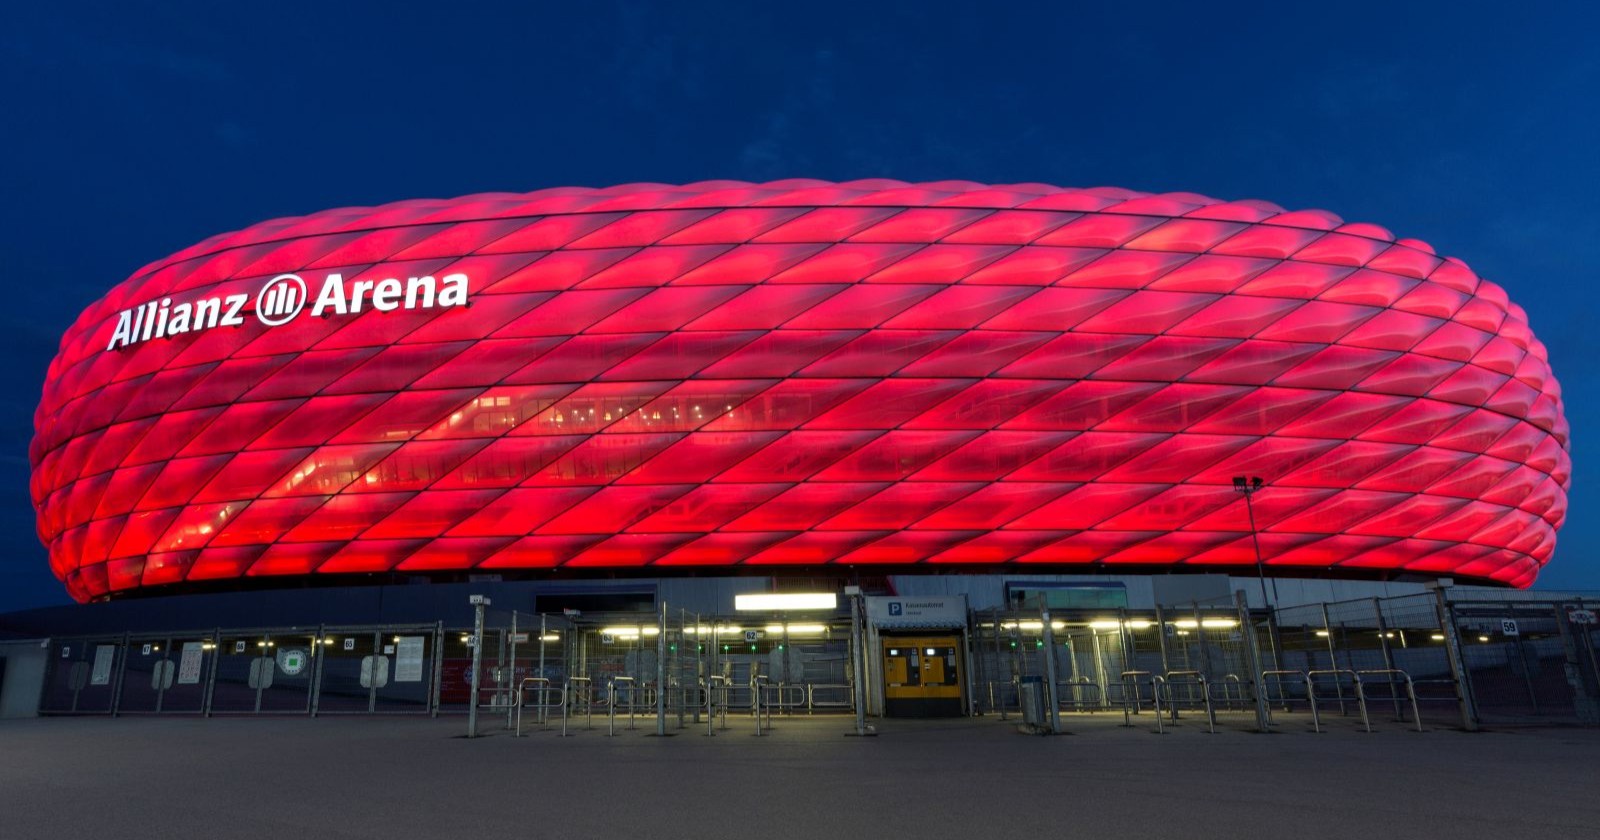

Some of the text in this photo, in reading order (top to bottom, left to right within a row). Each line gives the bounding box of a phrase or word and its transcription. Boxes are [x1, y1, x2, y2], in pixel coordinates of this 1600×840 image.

[107, 273, 469, 351] Allianz Arena
[892, 604, 899, 614] P
[1504, 622, 1516, 632] 59
[746, 632, 756, 640] 62
[345, 640, 353, 648] 65
